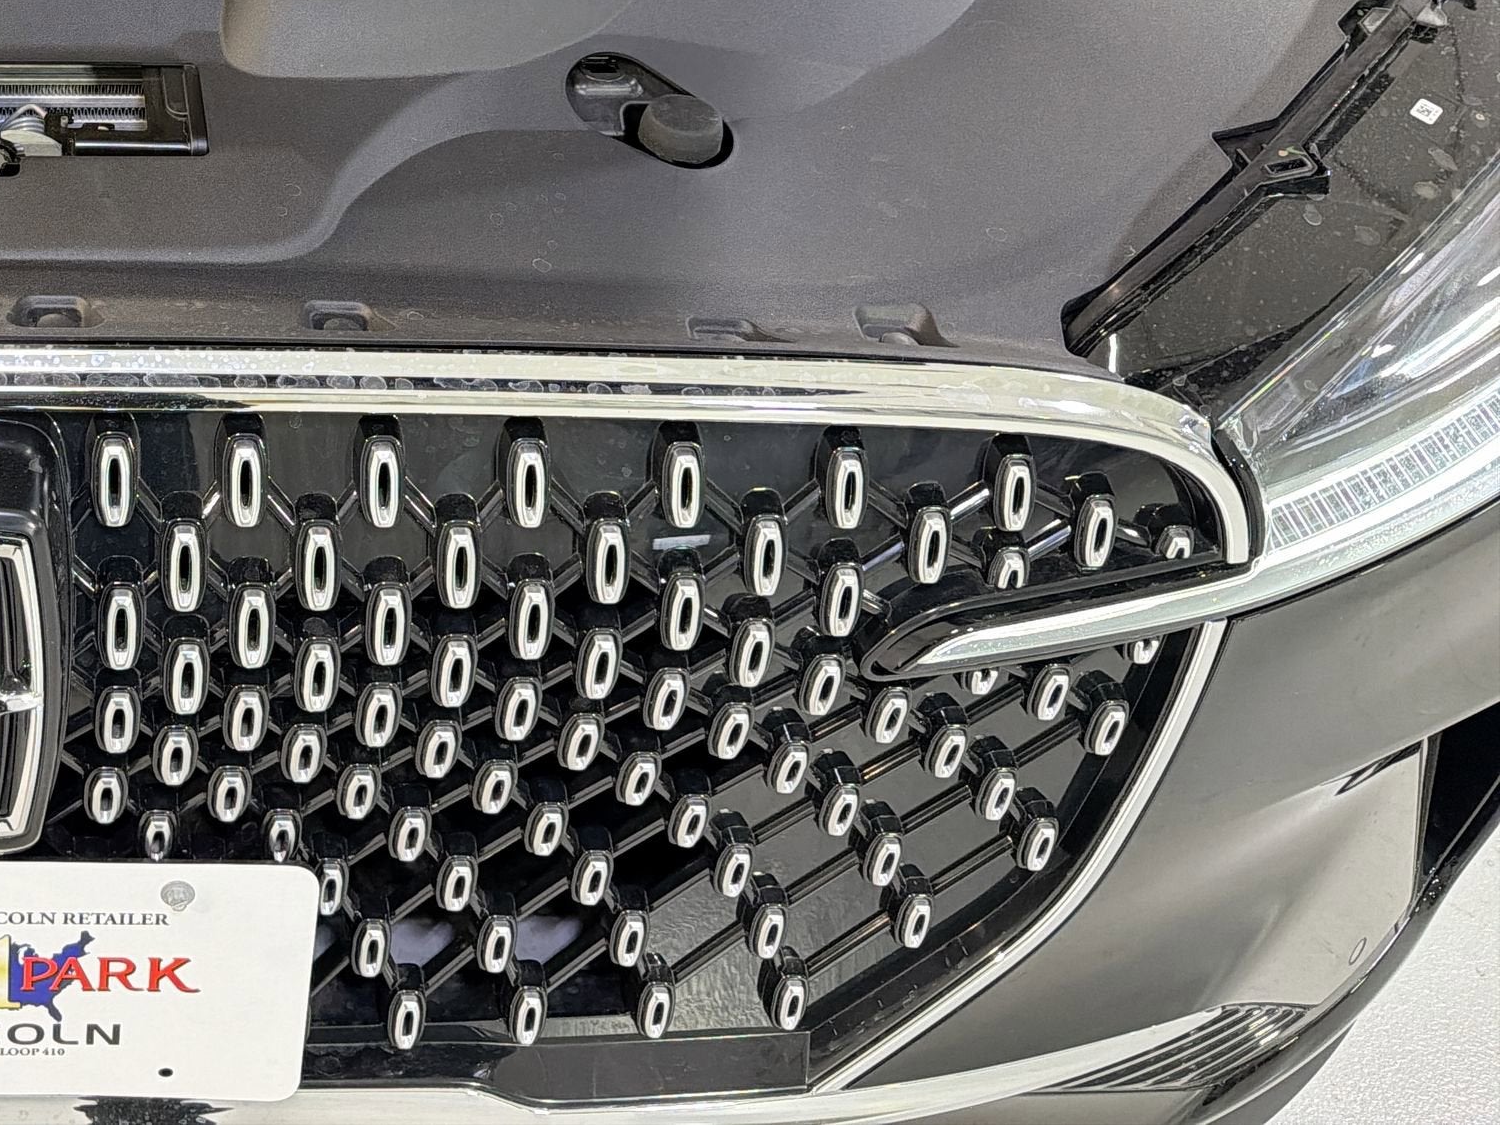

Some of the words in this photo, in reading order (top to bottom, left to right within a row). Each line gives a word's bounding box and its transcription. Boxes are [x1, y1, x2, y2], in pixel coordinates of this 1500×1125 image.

[63, 911, 169, 926] RETAILER
[20, 955, 201, 994] PARK
[0, 1048, 40, 1056] LOOP
[43, 1048, 65, 1056] 410
